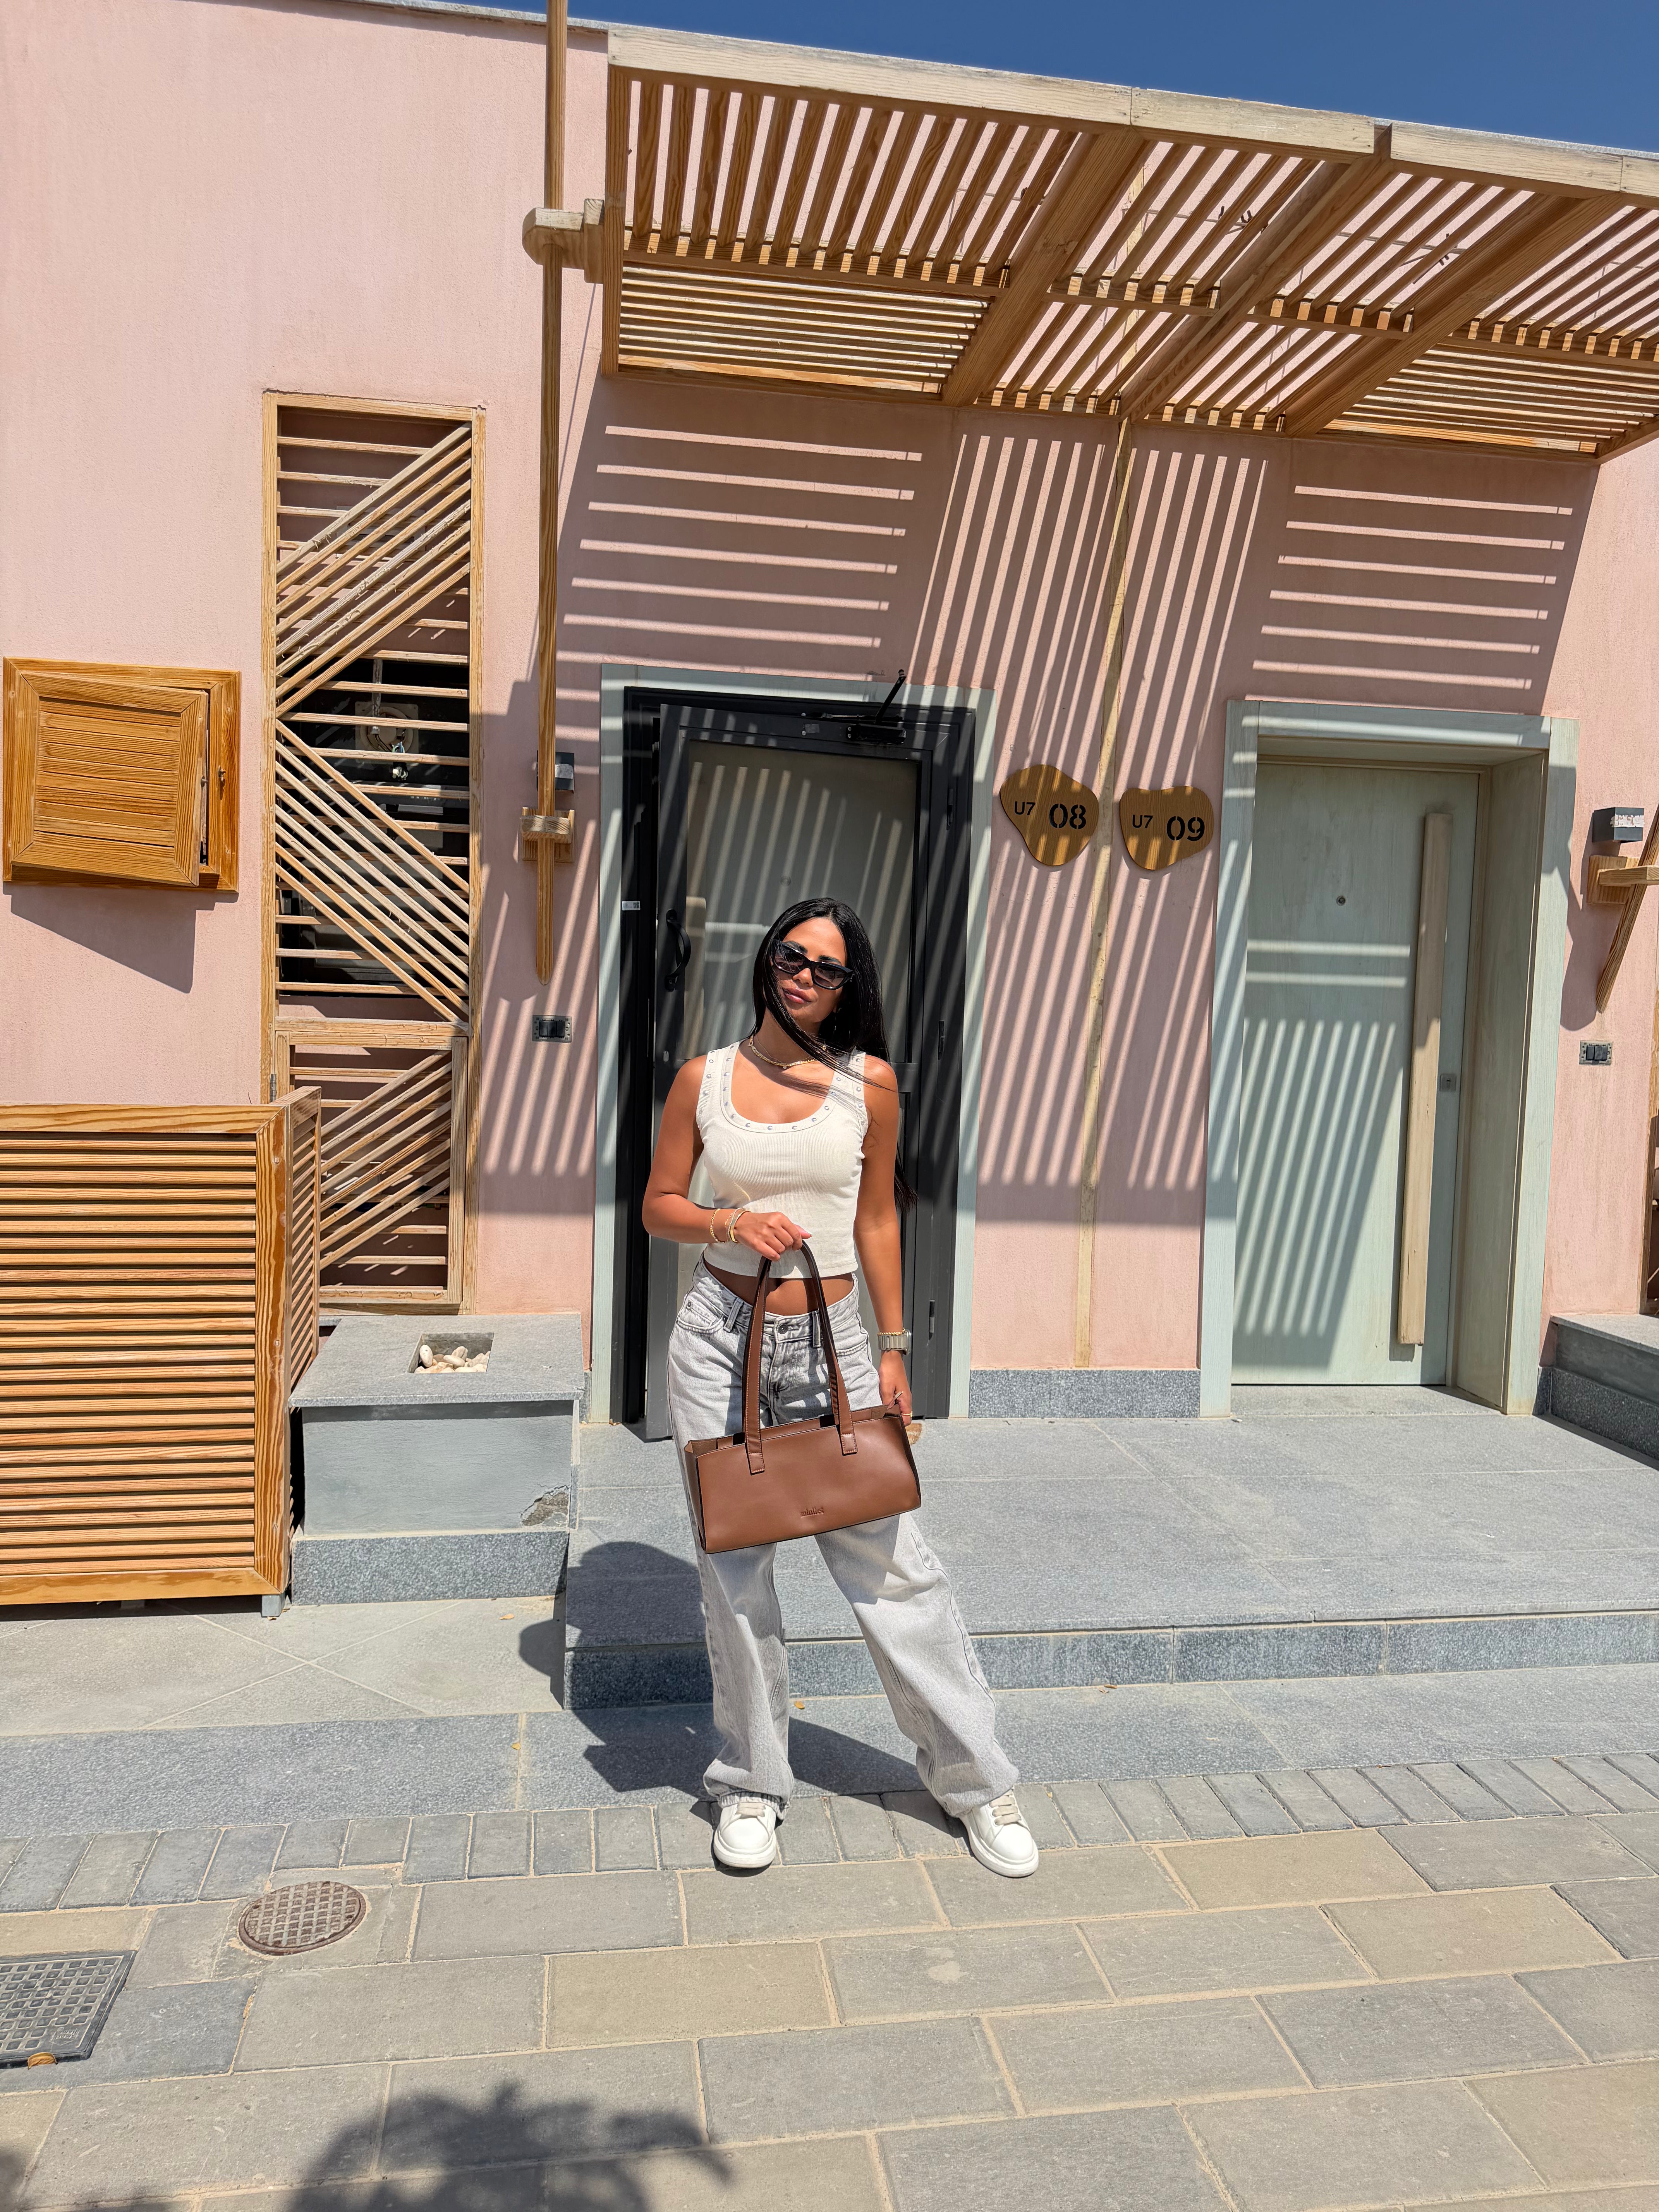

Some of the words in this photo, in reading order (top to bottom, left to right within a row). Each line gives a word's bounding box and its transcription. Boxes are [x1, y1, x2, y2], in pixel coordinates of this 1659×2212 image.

[1014, 801, 1036, 816] U7
[1049, 803, 1086, 829] 08
[1132, 814, 1153, 828] U7
[1167, 816, 1205, 841] 09
